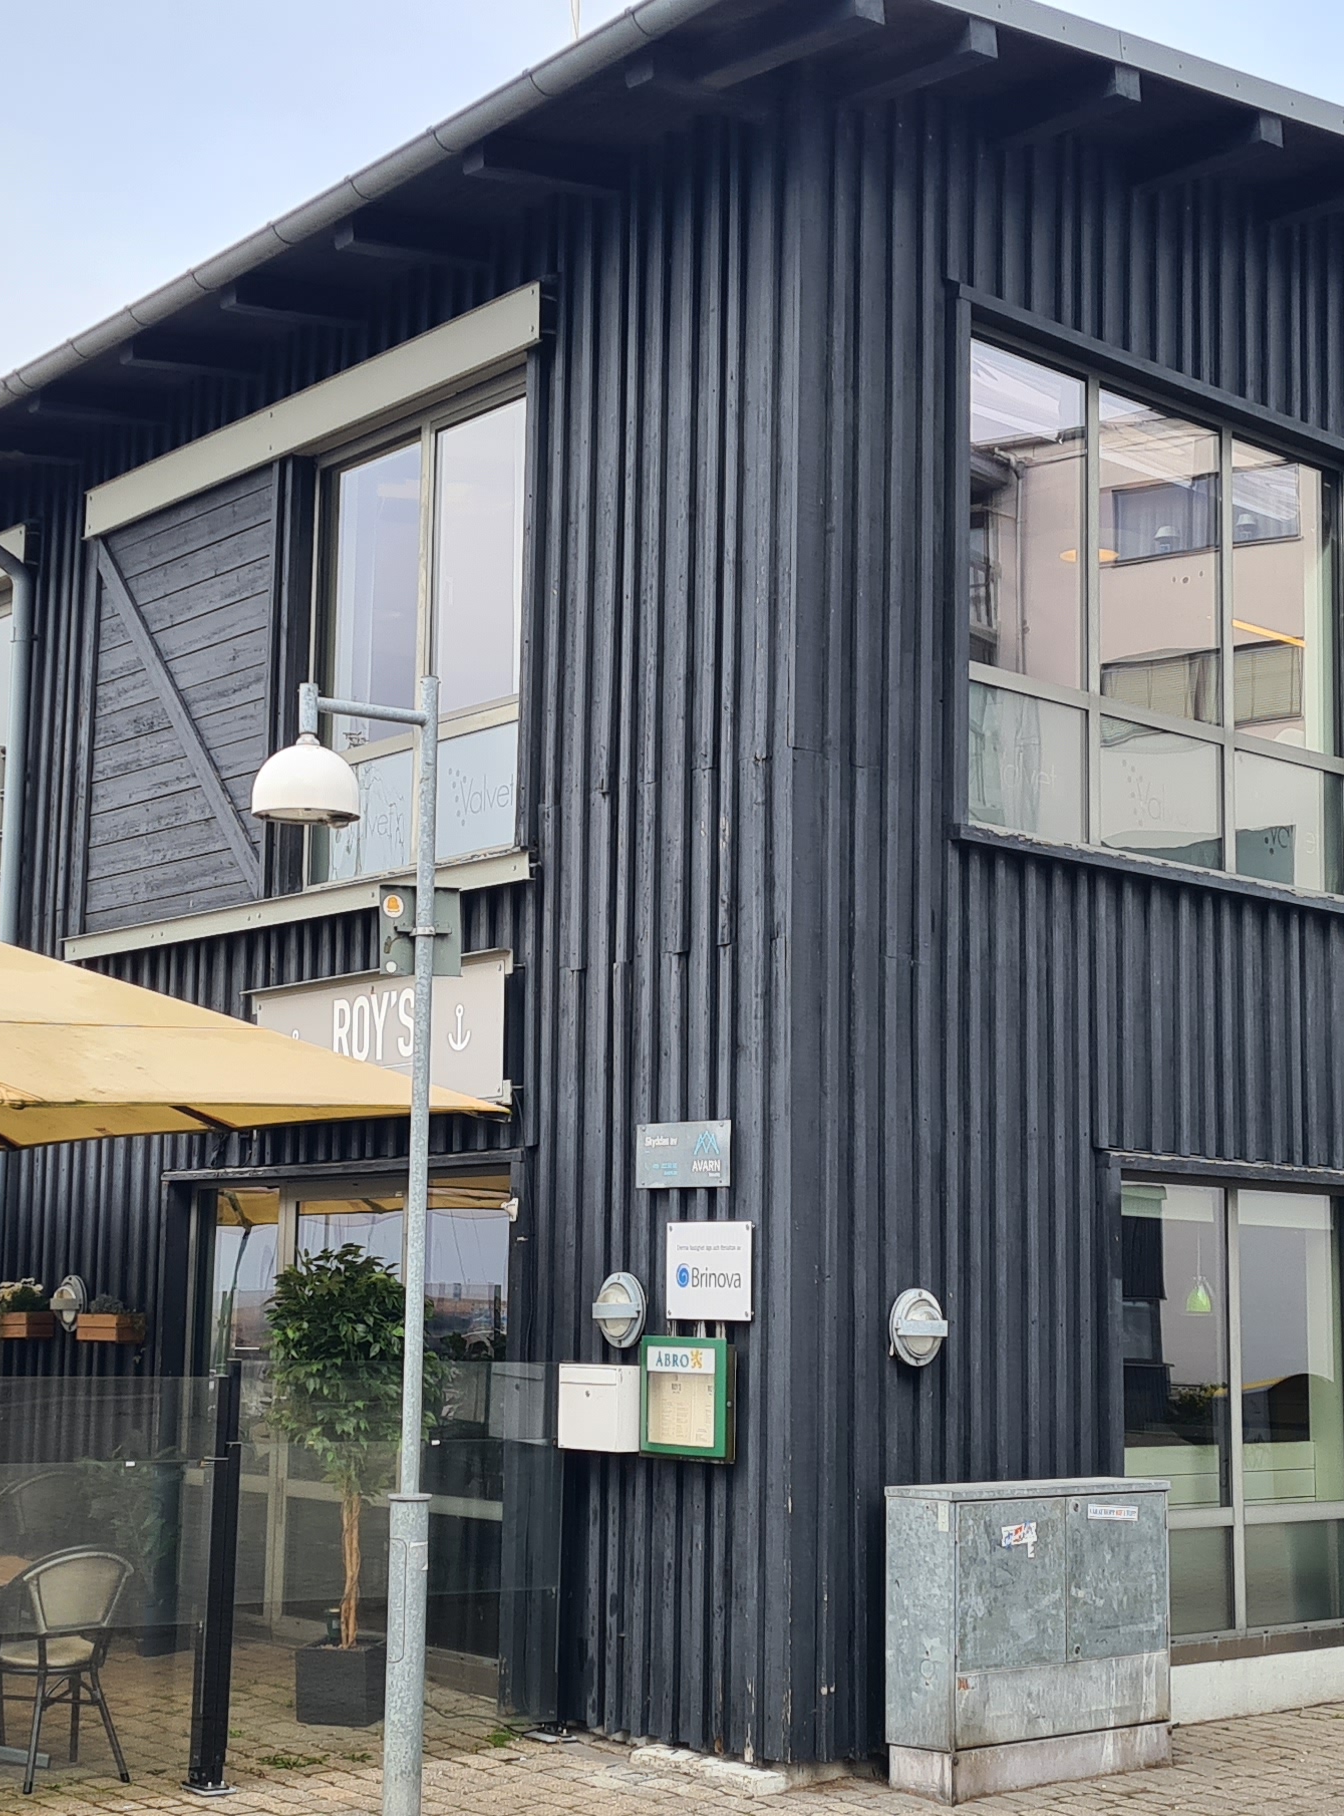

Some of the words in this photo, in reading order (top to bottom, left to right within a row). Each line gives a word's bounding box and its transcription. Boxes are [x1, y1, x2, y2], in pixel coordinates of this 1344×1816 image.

[460, 773, 515, 815] Valvet
[333, 987, 415, 1062] ROY'S
[692, 1159, 721, 1172] AVARN
[691, 1266, 741, 1289] Brinova
